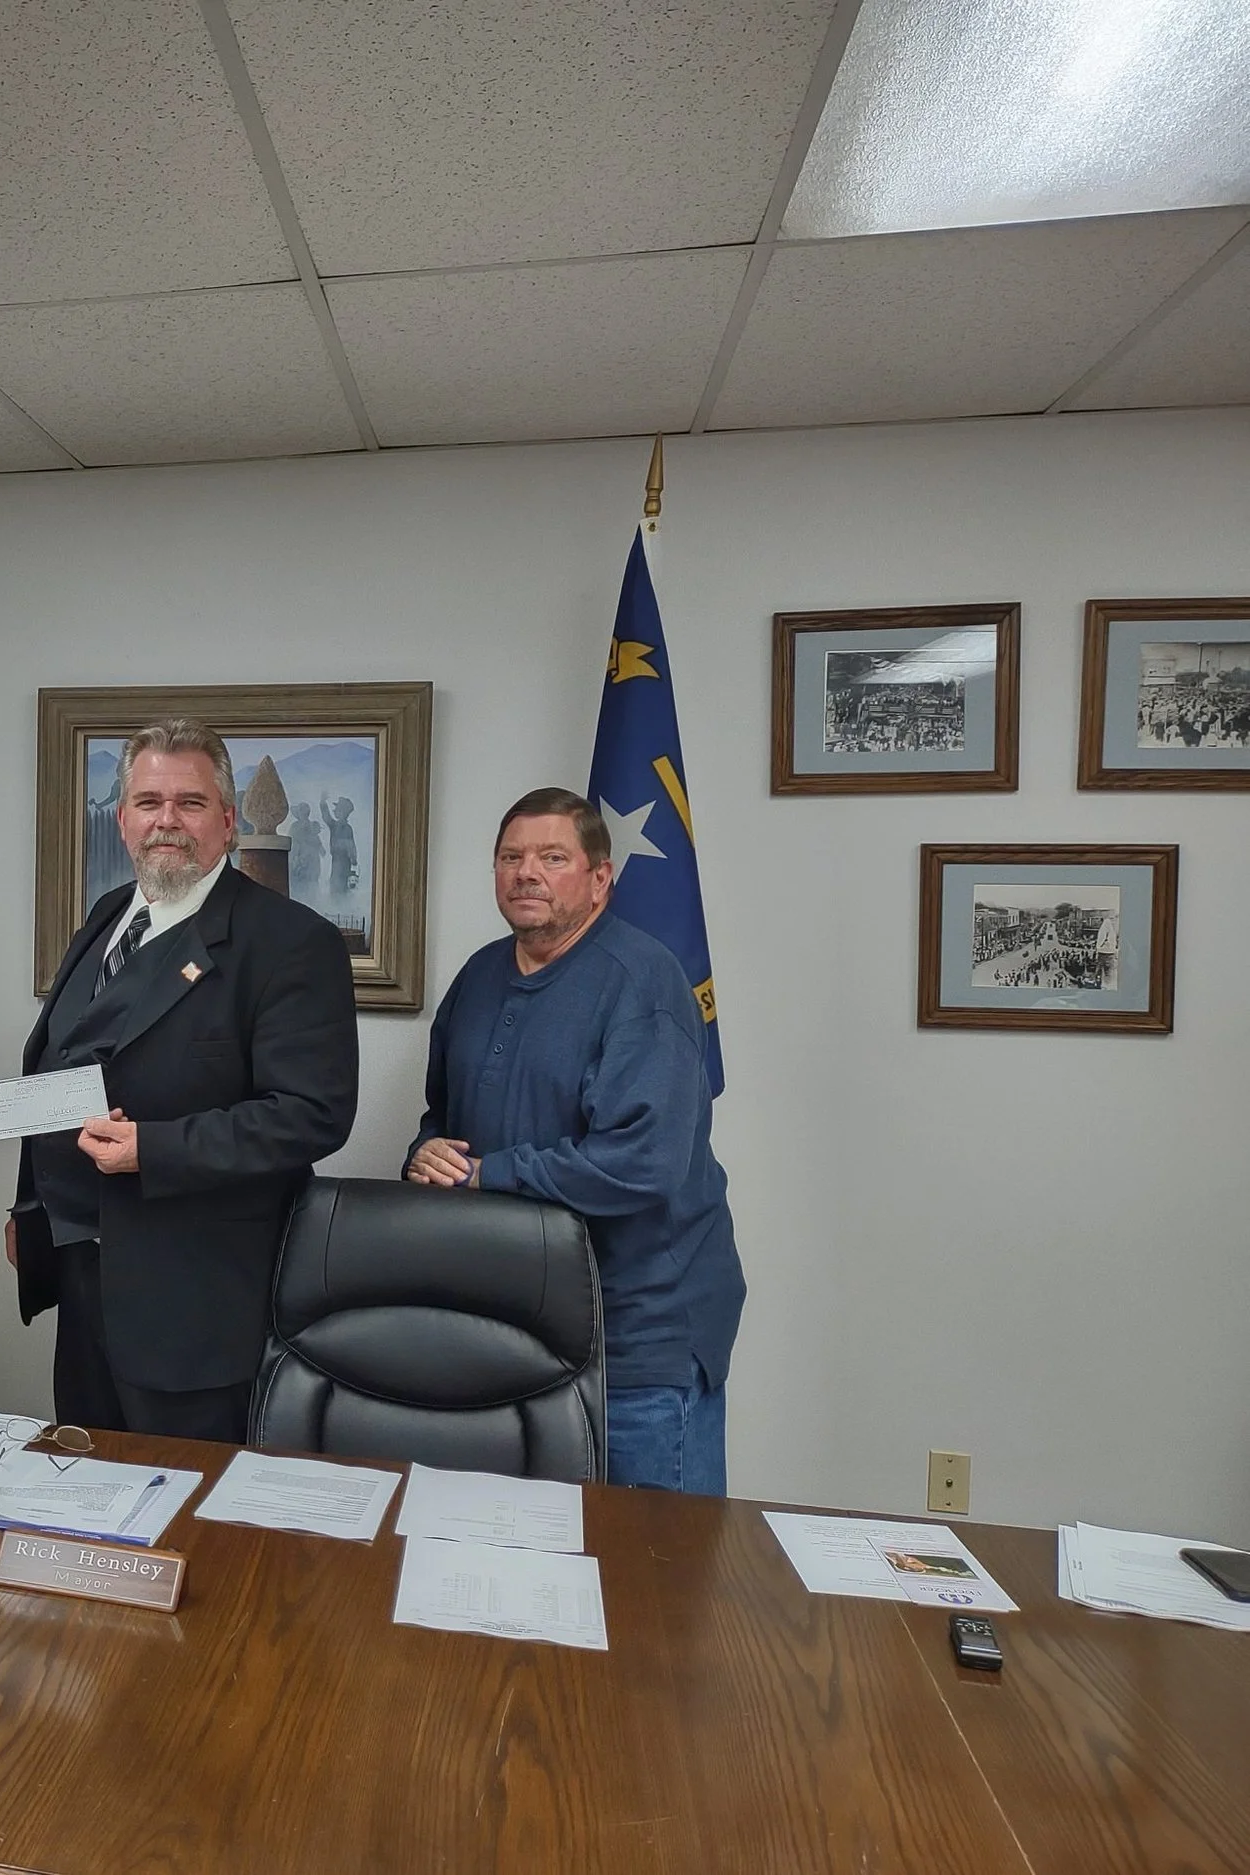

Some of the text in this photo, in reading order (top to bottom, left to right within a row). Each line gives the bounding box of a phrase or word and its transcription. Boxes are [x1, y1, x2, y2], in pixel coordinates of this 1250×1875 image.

[14, 1540, 164, 1581] Rick Hensley
[54, 1569, 114, 1590] Mayor
